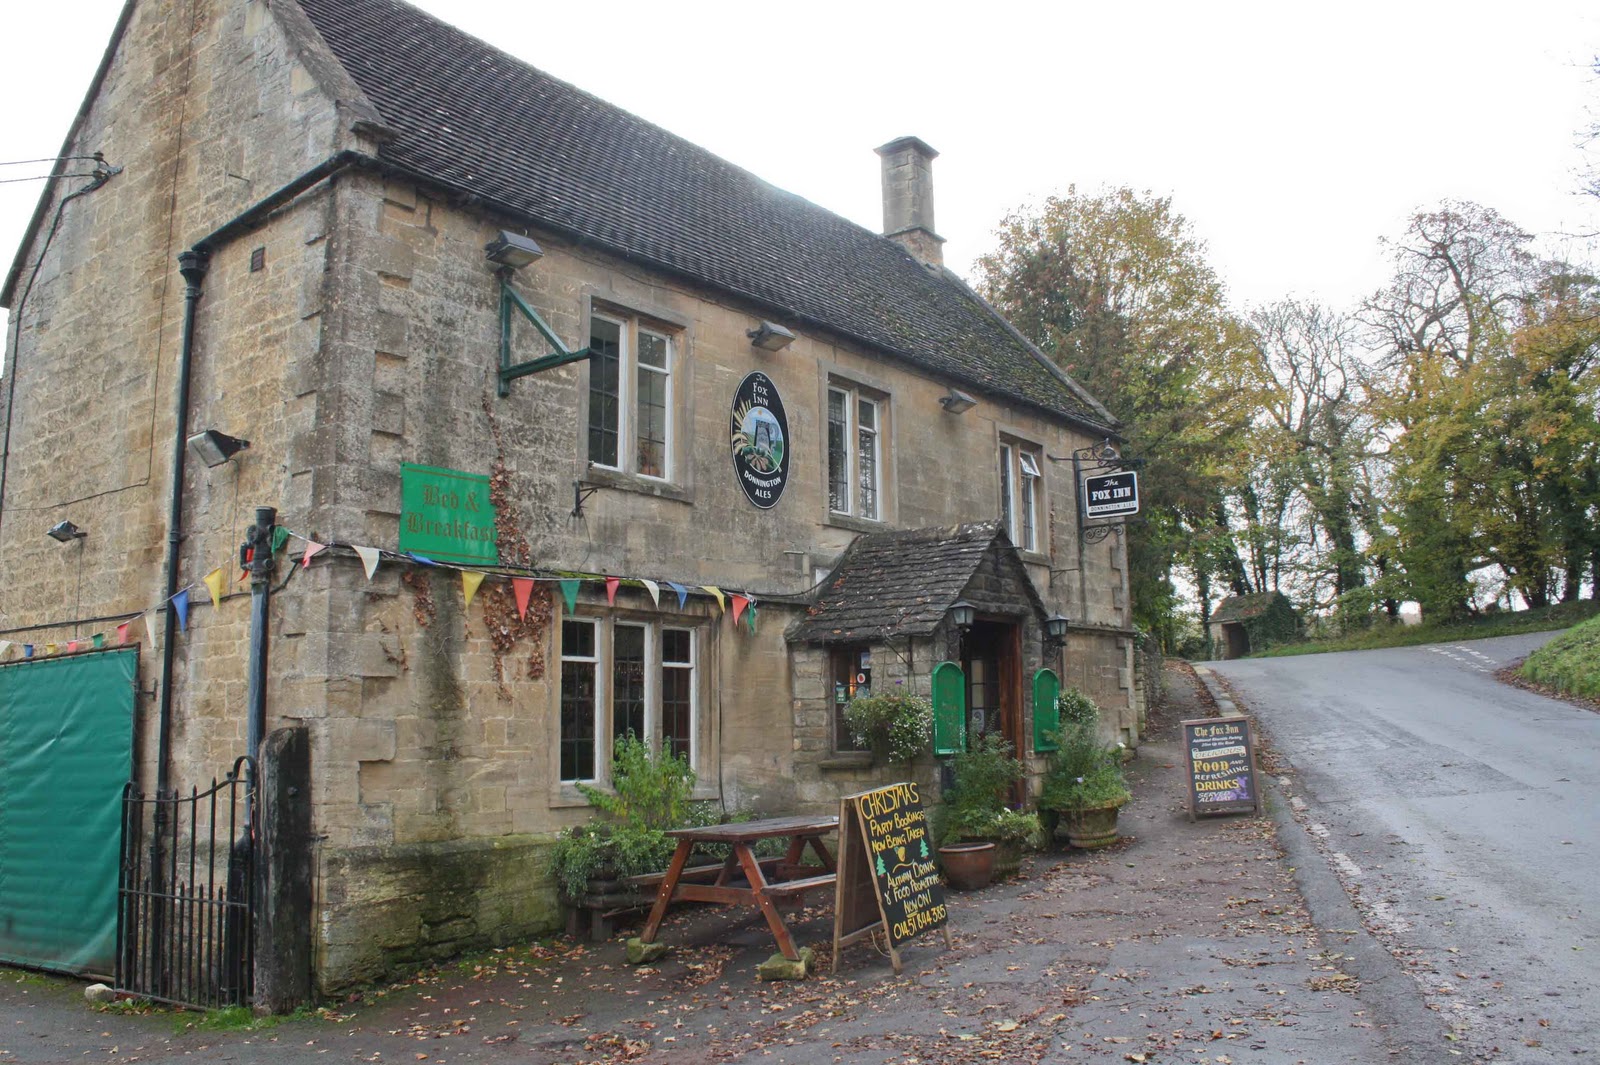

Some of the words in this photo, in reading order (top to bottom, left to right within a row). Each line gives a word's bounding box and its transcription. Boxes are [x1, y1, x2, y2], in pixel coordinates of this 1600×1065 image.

[744, 470, 782, 488] DONNINGTON
[1103, 479, 1119, 487] The
[423, 484, 459, 510] Bed
[464, 491, 480, 513] &
[755, 489, 771, 499] ALES
[1092, 490, 1111, 501] FOX
[1113, 487, 1131, 498] INN
[406, 511, 496, 542] Breakfast
[1194, 727, 1208, 737] The
[1209, 725, 1224, 737] Fox
[1225, 724, 1239, 735] Inn
[1195, 748, 1242, 758] DELICIOUS
[1193, 760, 1229, 773] FOOD
[1195, 765, 1249, 780] REFRESHING
[1195, 779, 1240, 791] DRINKS
[861, 782, 919, 820] CHRISTMAS
[1198, 790, 1231, 799] SERVED
[870, 819, 893, 837] PARTY
[894, 810, 925, 829] BOOKINGS
[872, 840, 886, 853] NOW
[886, 834, 907, 849] BEING
[903, 827, 925, 843] TAKEN
[887, 870, 913, 889] AUTUMN
[912, 859, 936, 878] DRINK
[893, 886, 911, 903] FOOD
[903, 898, 918, 914] NOW
